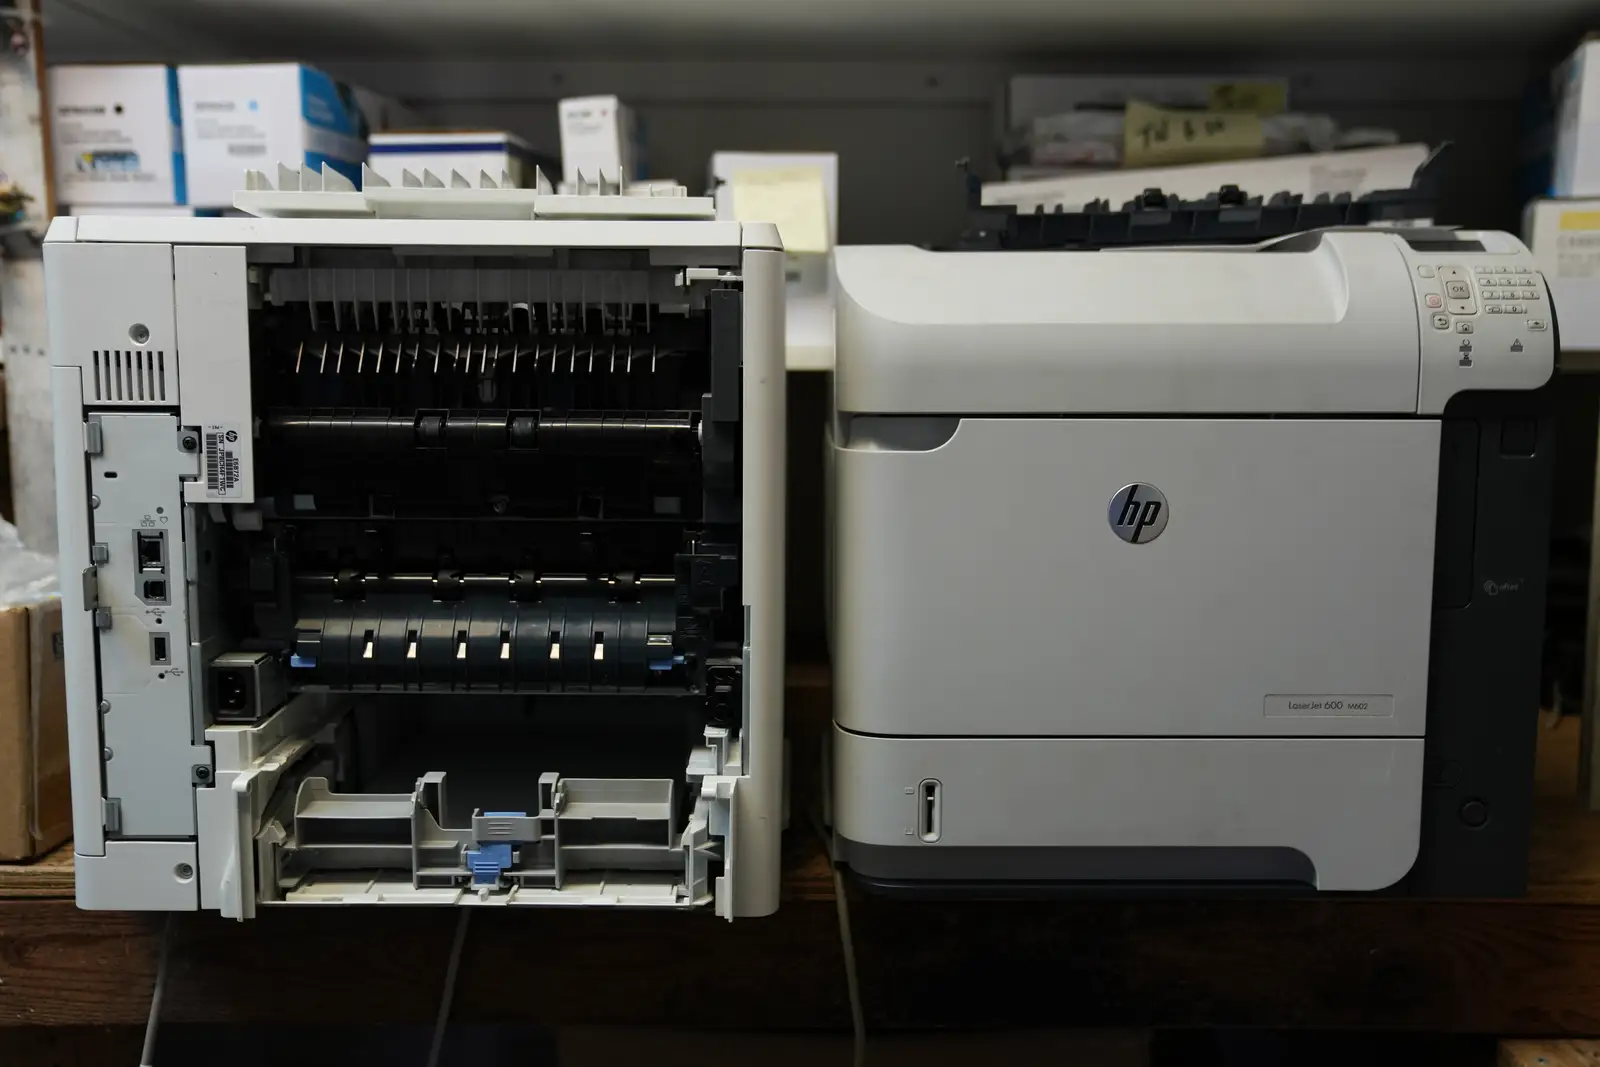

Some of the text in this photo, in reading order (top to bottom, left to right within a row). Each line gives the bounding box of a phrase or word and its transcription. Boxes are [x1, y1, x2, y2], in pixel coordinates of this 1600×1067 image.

[1452, 285, 1465, 293] OK
[218, 434, 224, 444] SN
[226, 430, 238, 442] hp
[1115, 483, 1163, 543] hp
[1288, 701, 1368, 710] LaserJet 600 M602
